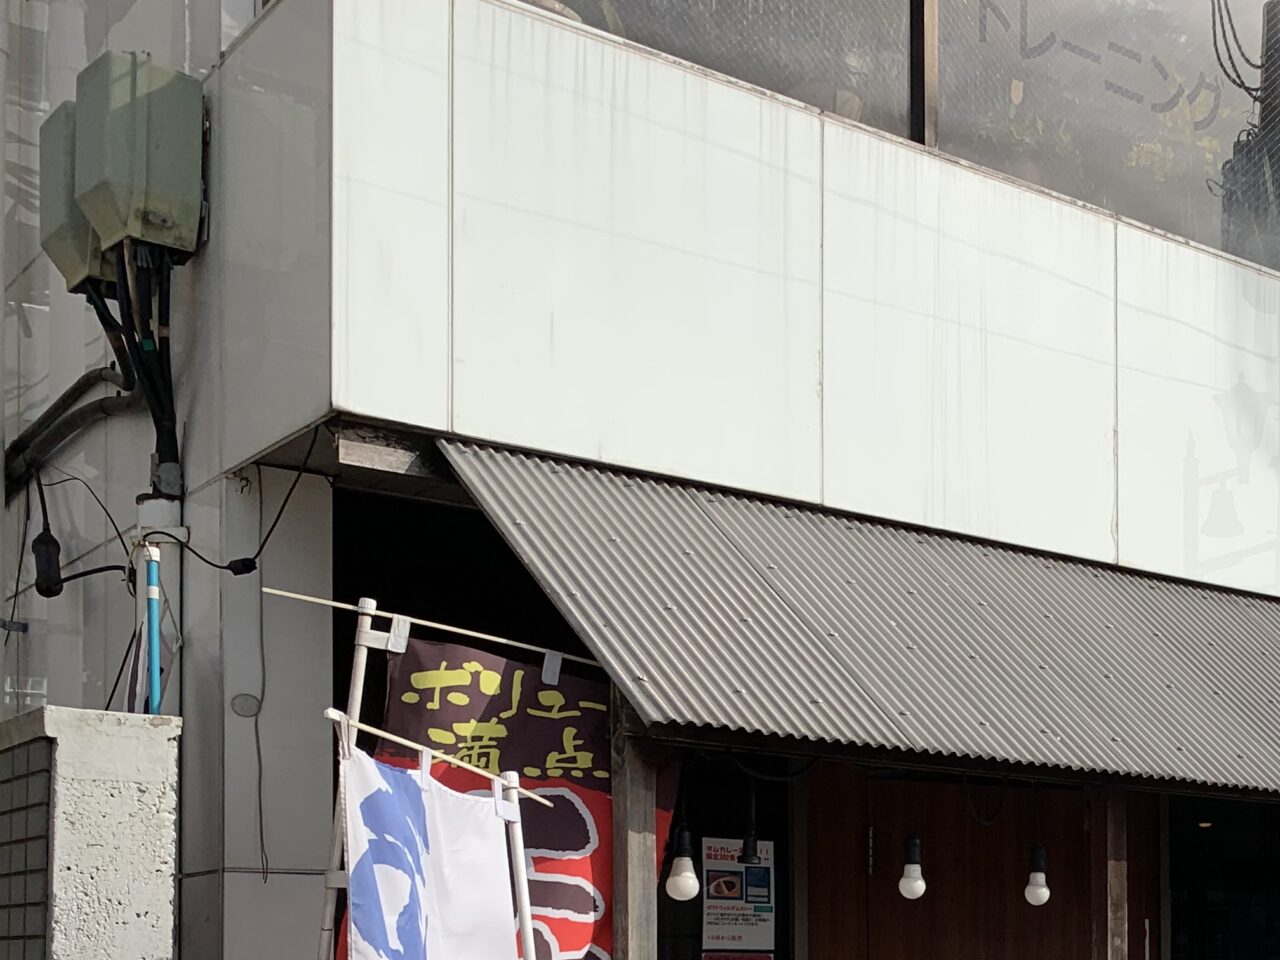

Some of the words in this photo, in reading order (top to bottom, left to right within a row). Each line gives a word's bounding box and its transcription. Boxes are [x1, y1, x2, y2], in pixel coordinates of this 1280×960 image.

[401, 660, 608, 719] ボリュー
[426, 718, 611, 778] 満点
